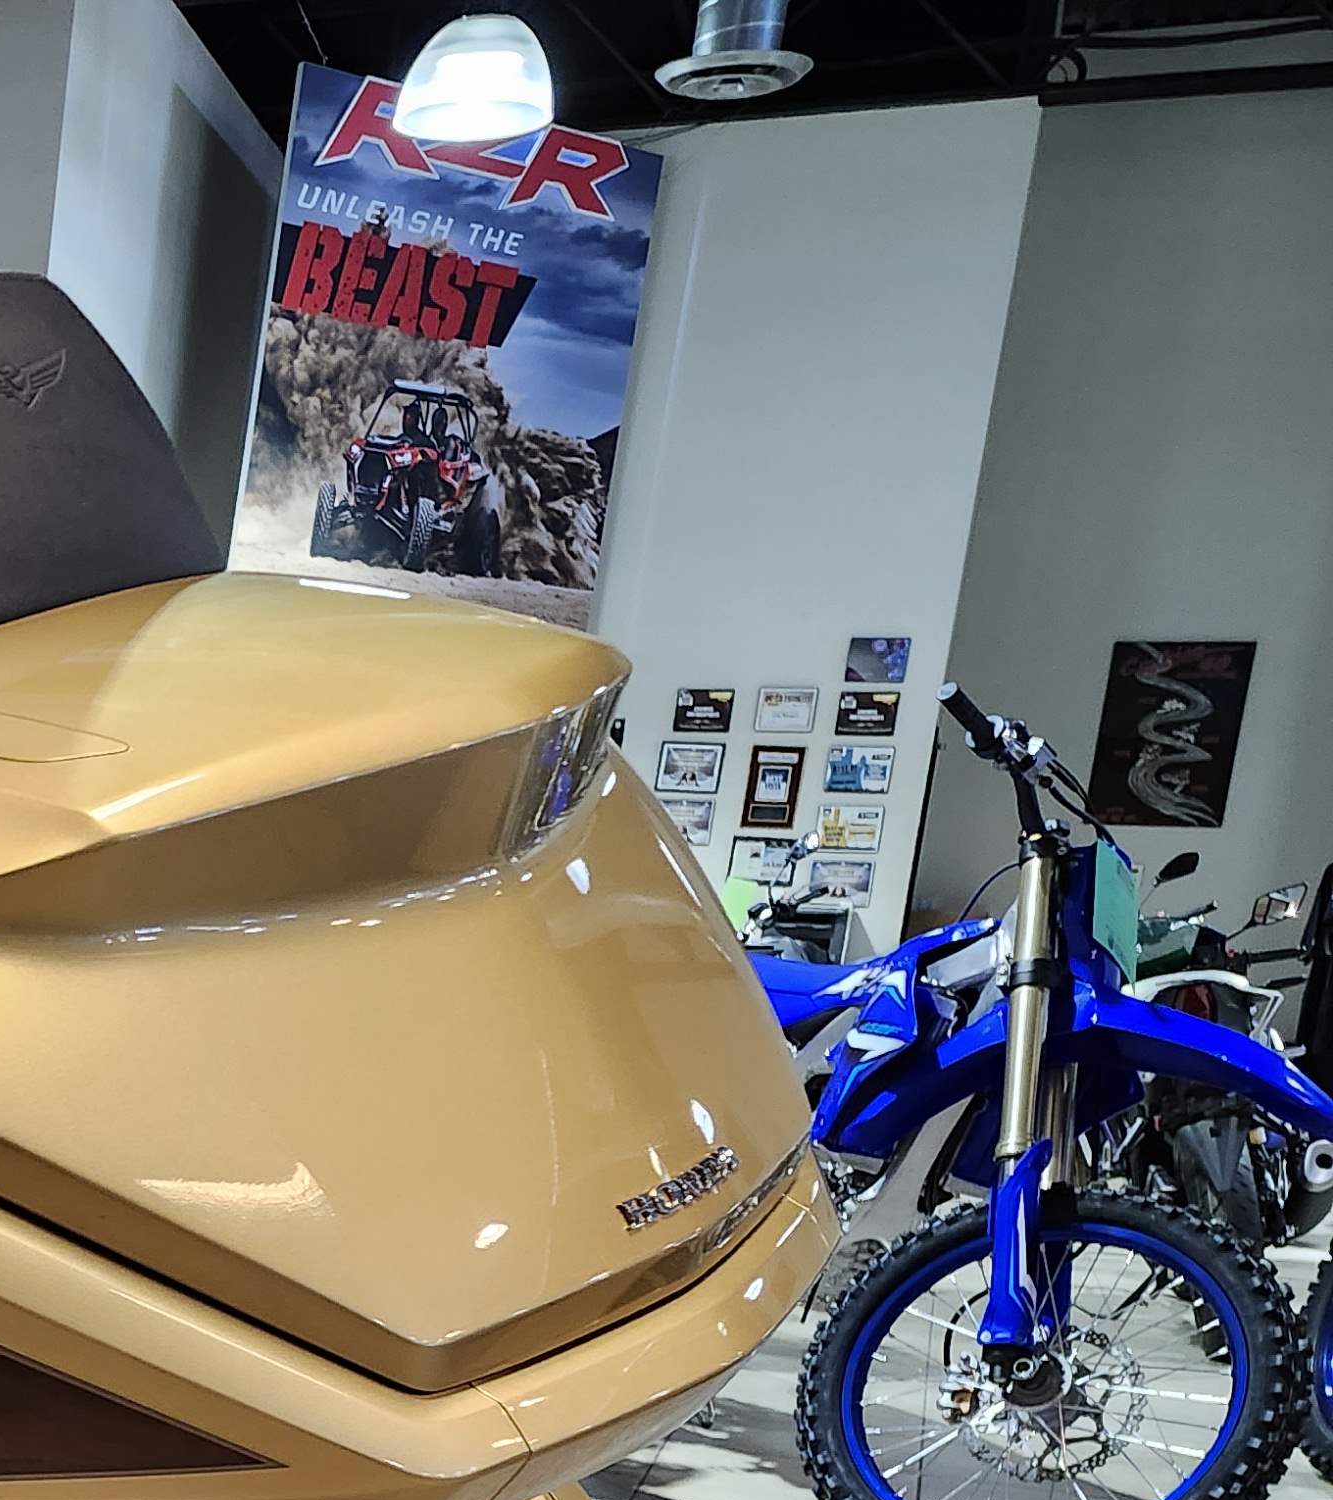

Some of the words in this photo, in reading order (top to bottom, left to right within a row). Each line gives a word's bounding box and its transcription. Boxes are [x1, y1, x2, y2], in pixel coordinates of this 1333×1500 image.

[297, 182, 455, 240] UNLEASH
[468, 222, 525, 256] THE
[282, 220, 520, 348] BEAST
[616, 1146, 741, 1231] HONDA
